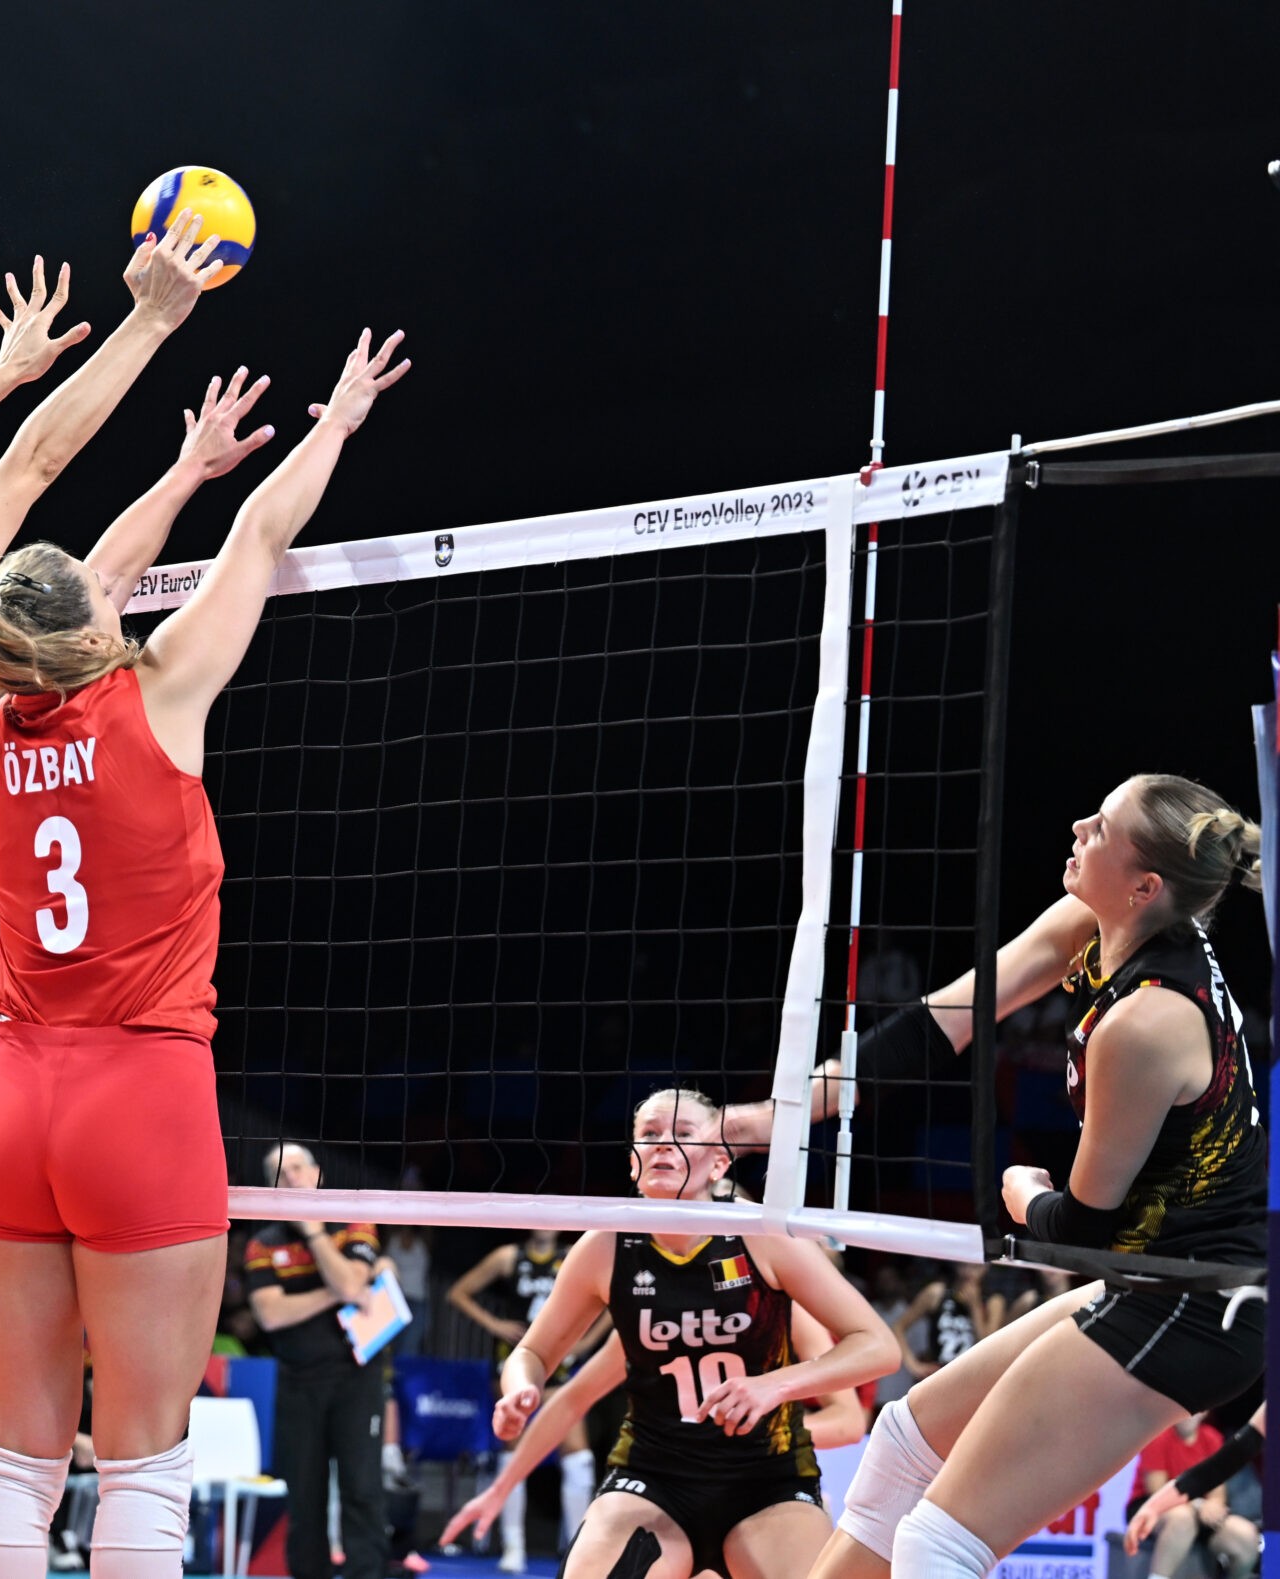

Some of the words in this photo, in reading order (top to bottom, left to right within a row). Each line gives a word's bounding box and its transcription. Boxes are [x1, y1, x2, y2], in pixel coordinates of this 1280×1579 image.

[934, 469, 980, 495] CEV
[633, 509, 669, 535] CEV
[673, 498, 766, 531] EuroVolley
[770, 490, 814, 518] 2023
[161, 568, 205, 594] EuroV
[3, 737, 96, 796] ÖZBAY
[33, 815, 89, 954] 3
[659, 1352, 747, 1424] 10
